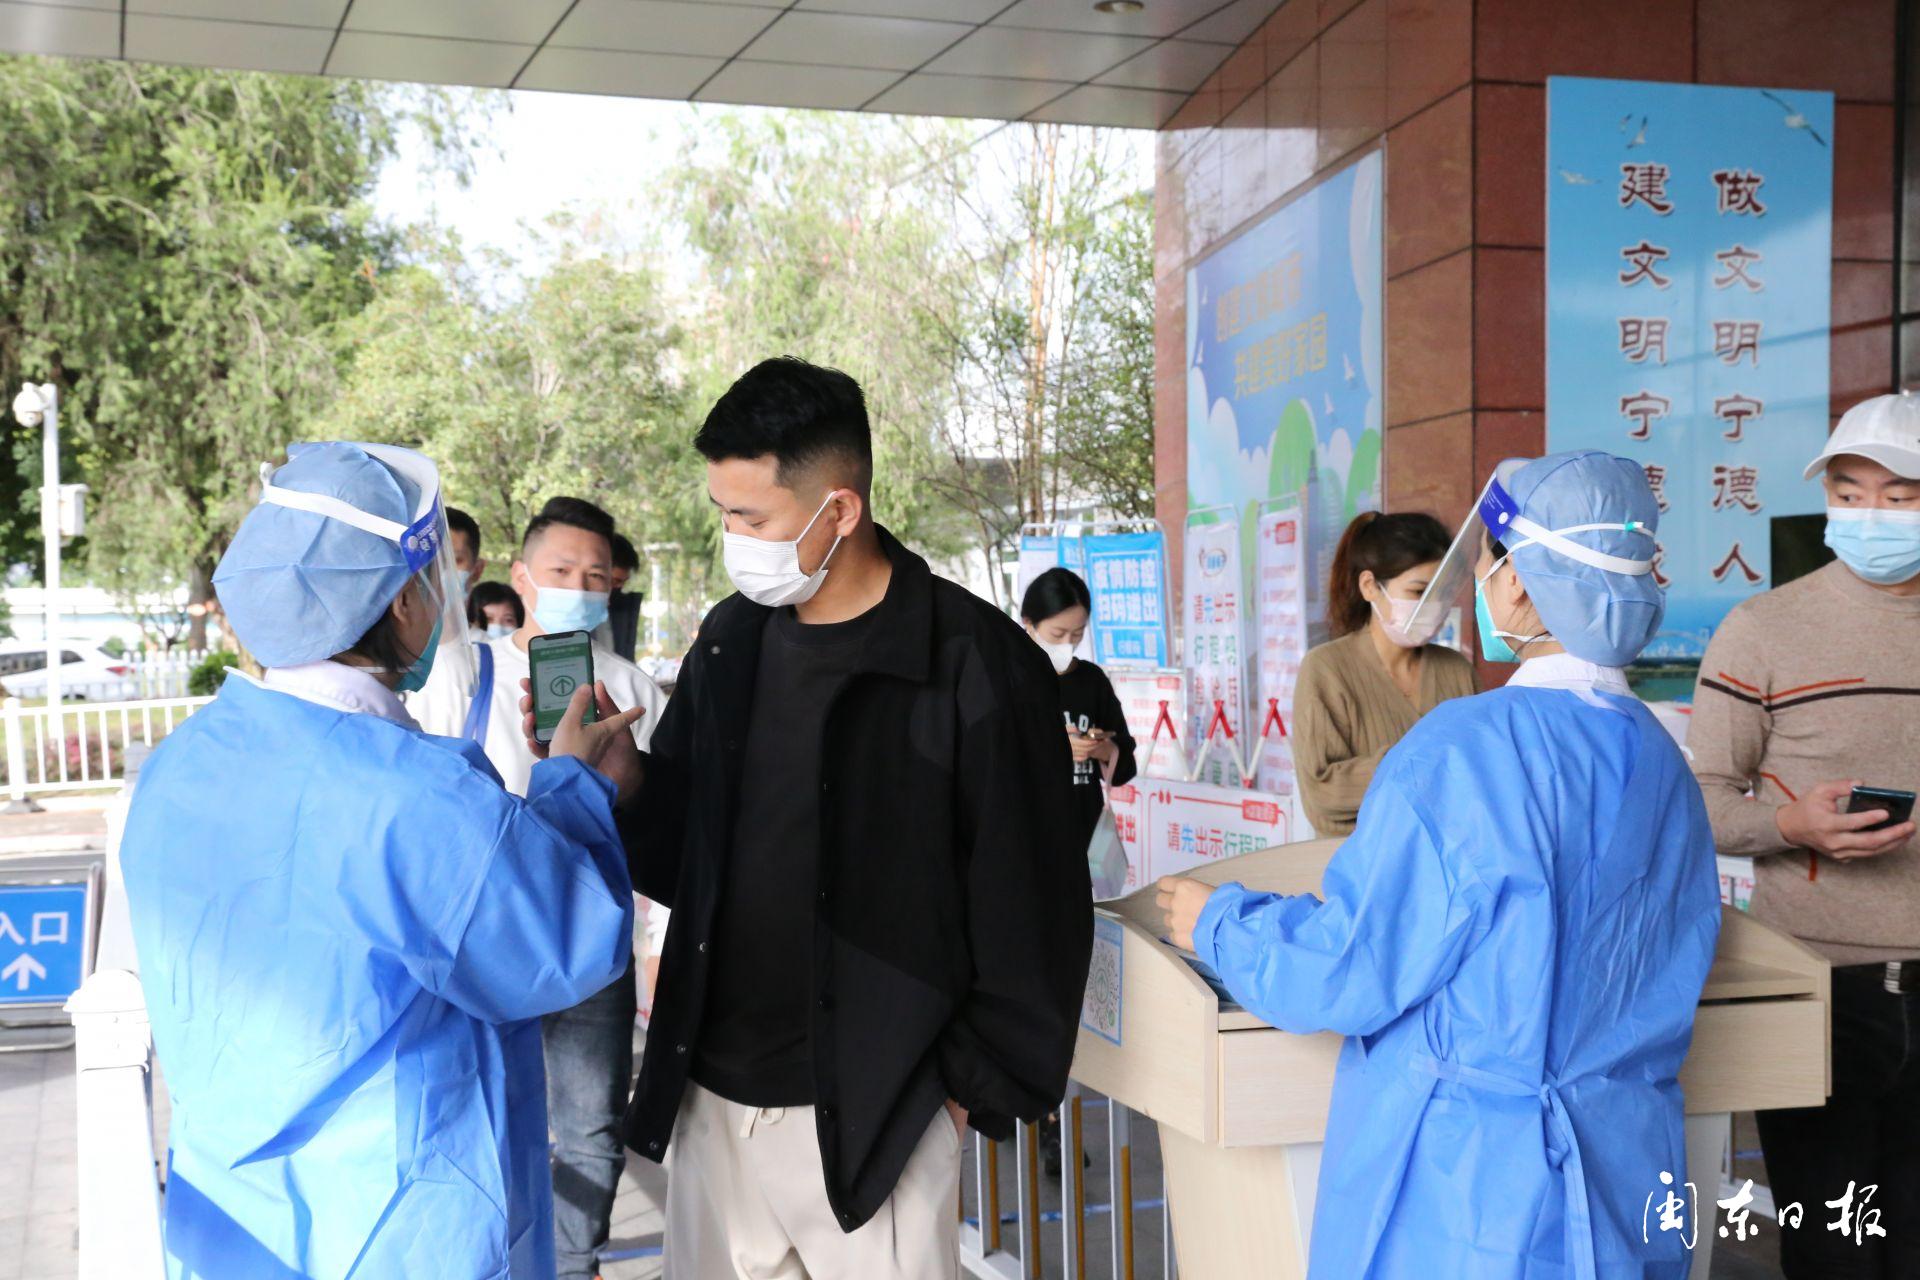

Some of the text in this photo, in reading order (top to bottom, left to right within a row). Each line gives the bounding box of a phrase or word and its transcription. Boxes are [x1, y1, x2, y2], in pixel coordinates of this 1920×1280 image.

[1619, 163, 1669, 585] 建文明宁
[1712, 170, 1764, 583] 做文明宁德人
[0, 911, 69, 945] 入口
